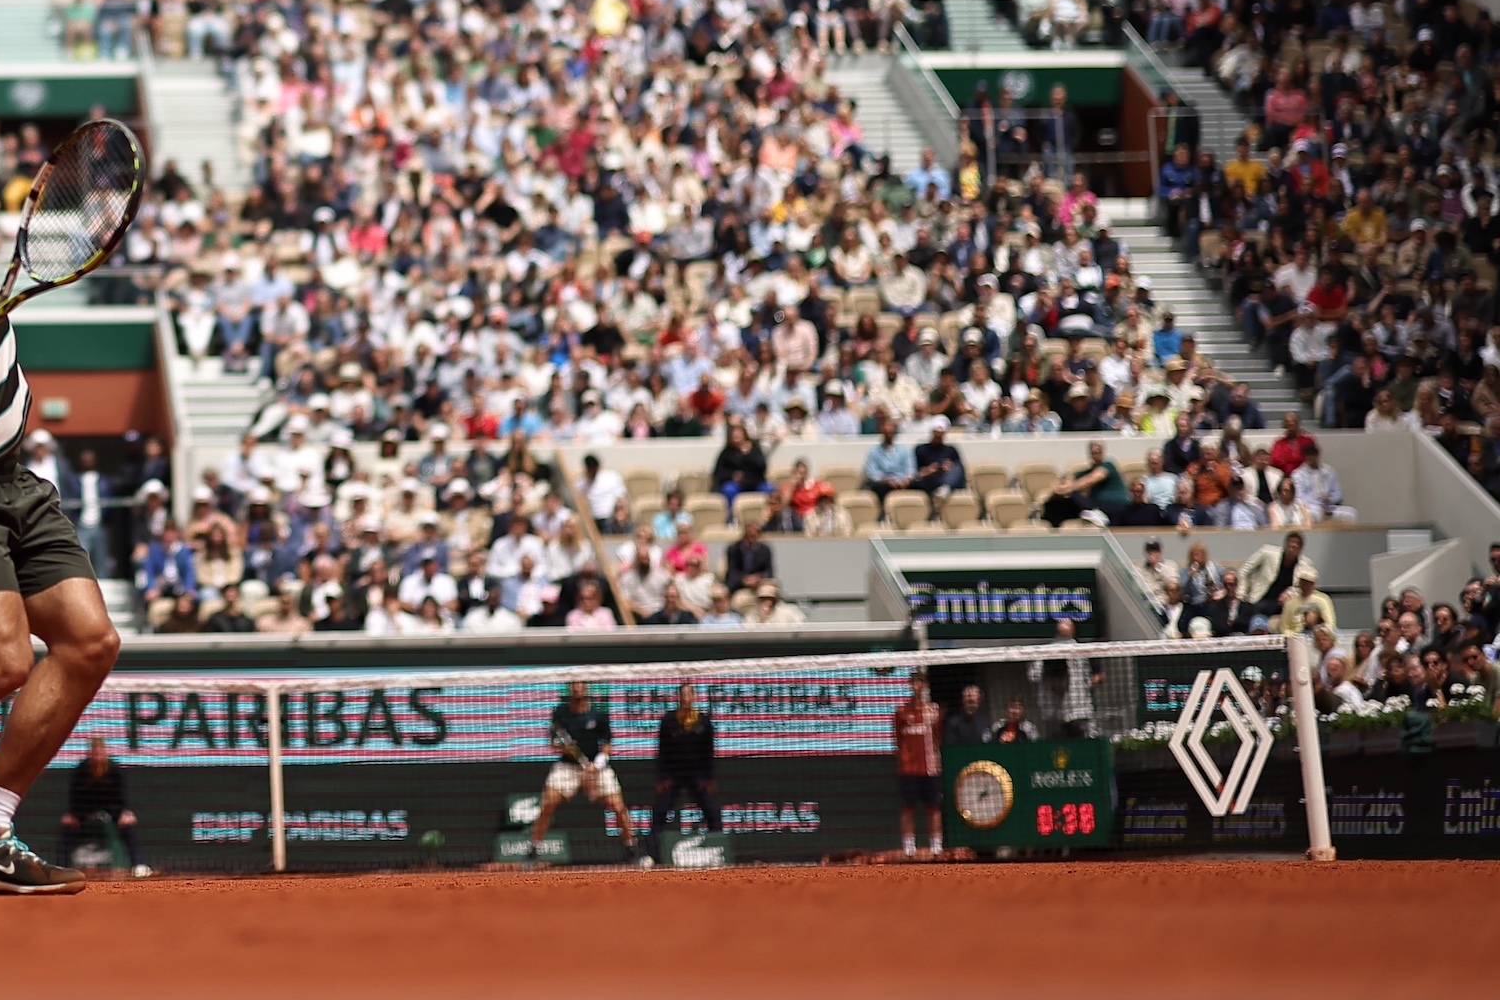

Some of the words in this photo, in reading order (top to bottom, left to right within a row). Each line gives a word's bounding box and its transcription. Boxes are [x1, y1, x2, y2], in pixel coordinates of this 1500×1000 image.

[908, 581, 1092, 625] Emirates
[127, 687, 446, 750] PARIBAS
[679, 801, 821, 835] PRIBAS
